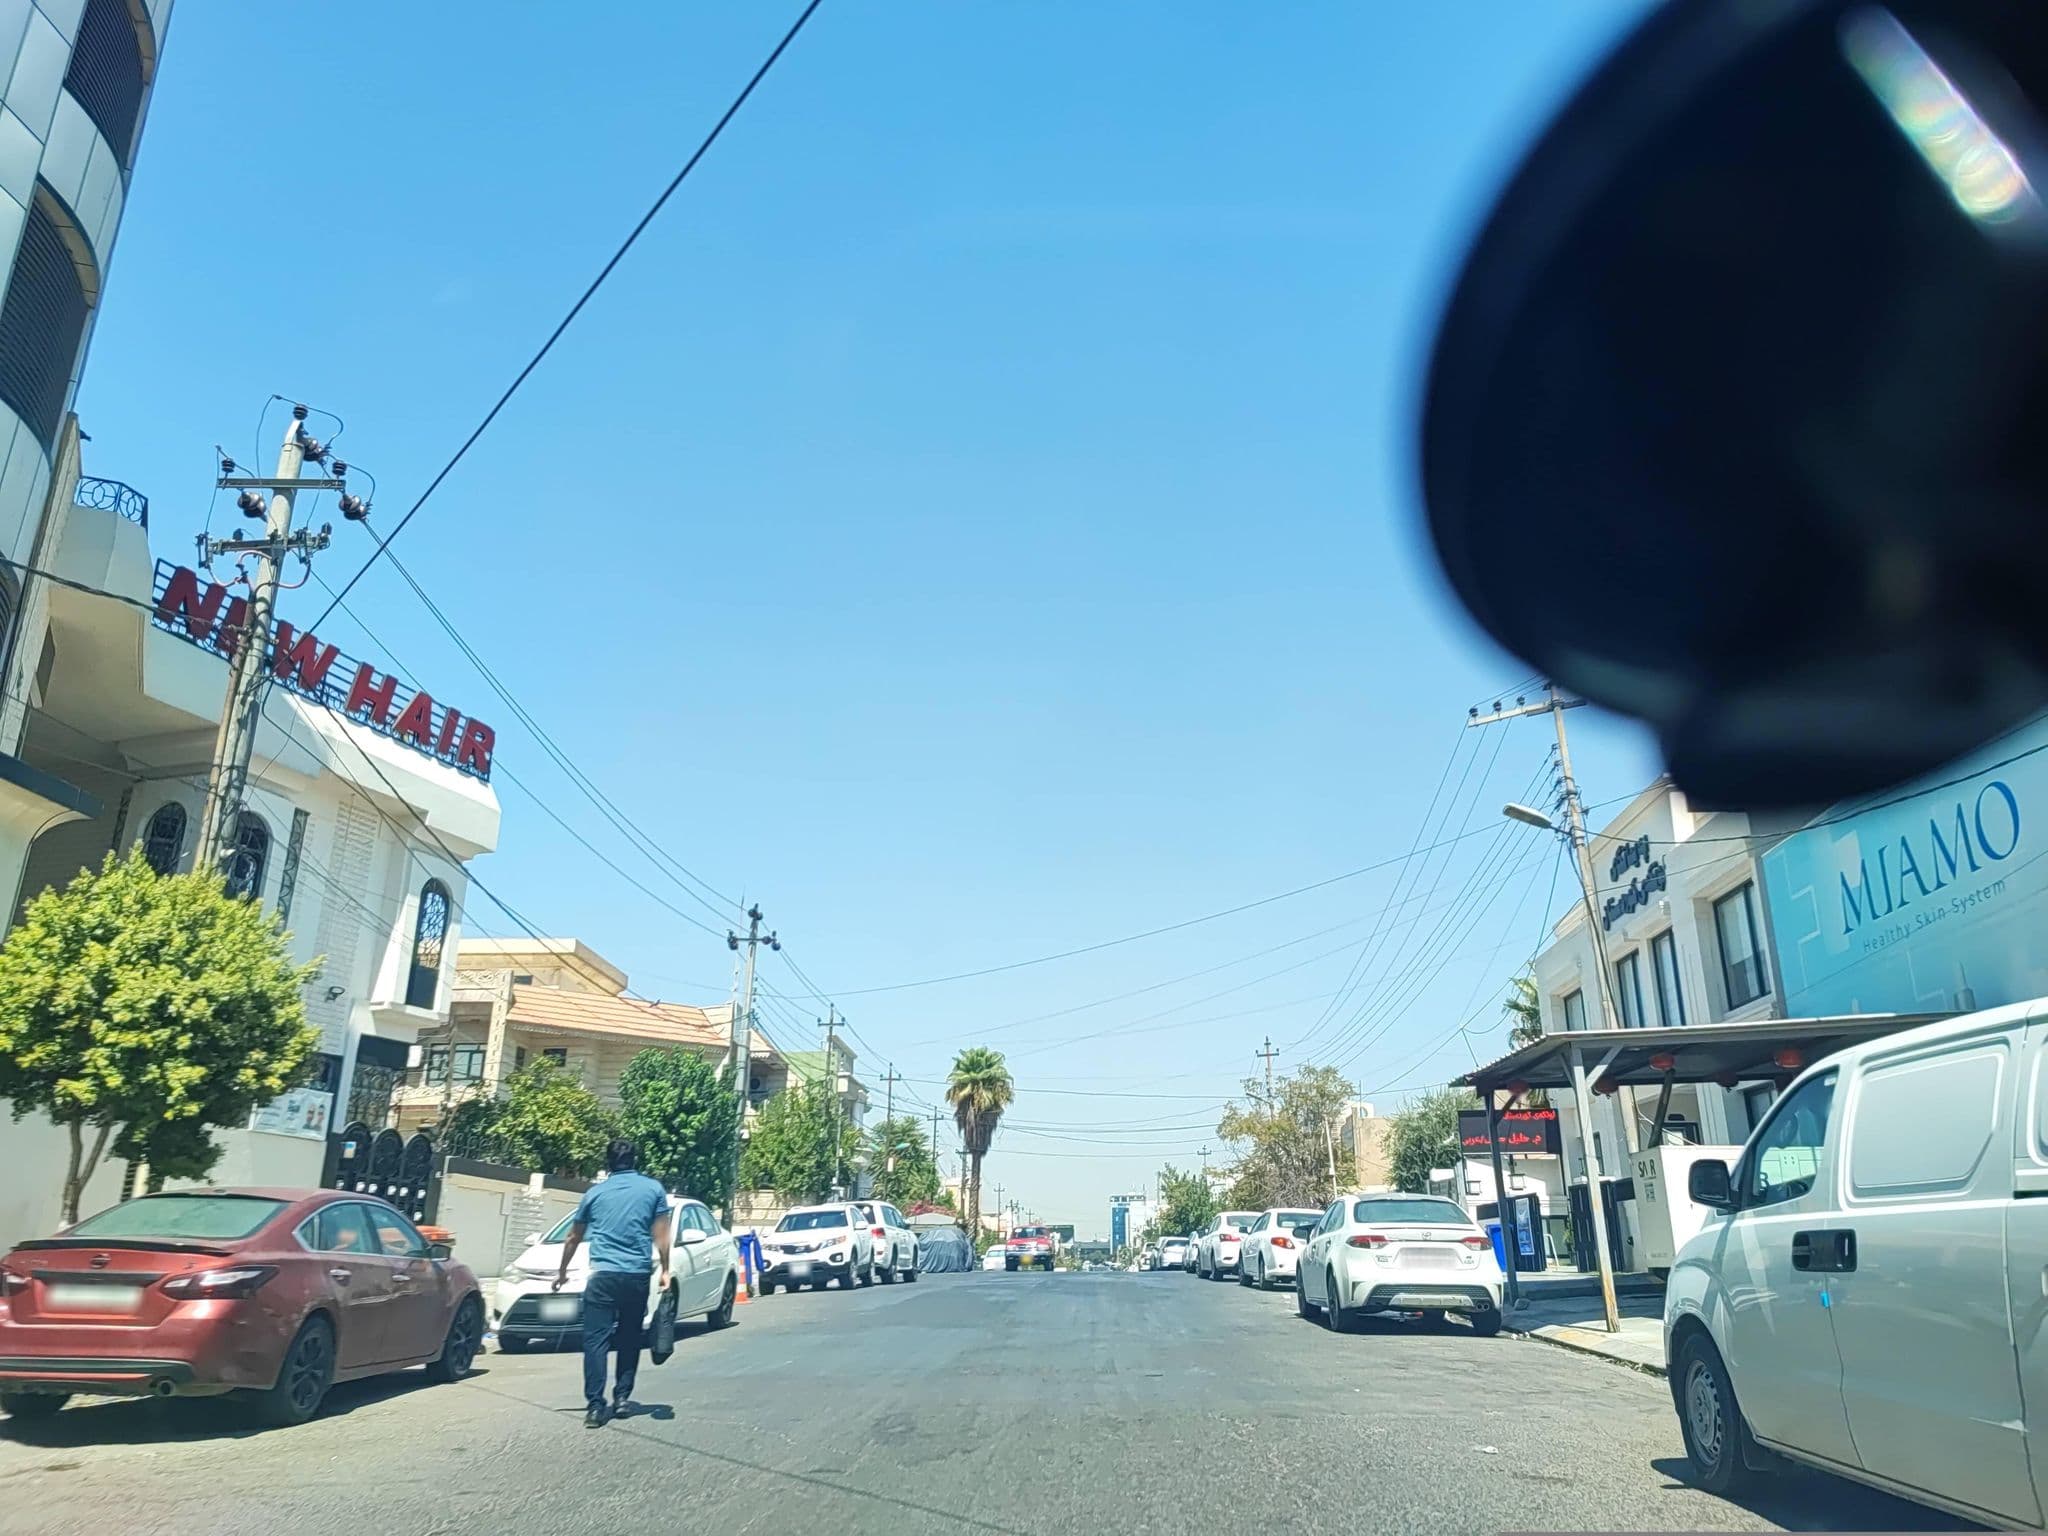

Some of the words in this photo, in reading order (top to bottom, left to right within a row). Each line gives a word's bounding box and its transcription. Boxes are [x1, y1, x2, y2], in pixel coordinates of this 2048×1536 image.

[346, 661, 496, 774] HAIR
[1840, 781, 2020, 935] MIAMO
[1862, 922, 1911, 952] Healthy
[1915, 906, 1947, 930] Skin
[1951, 879, 2007, 914] System
